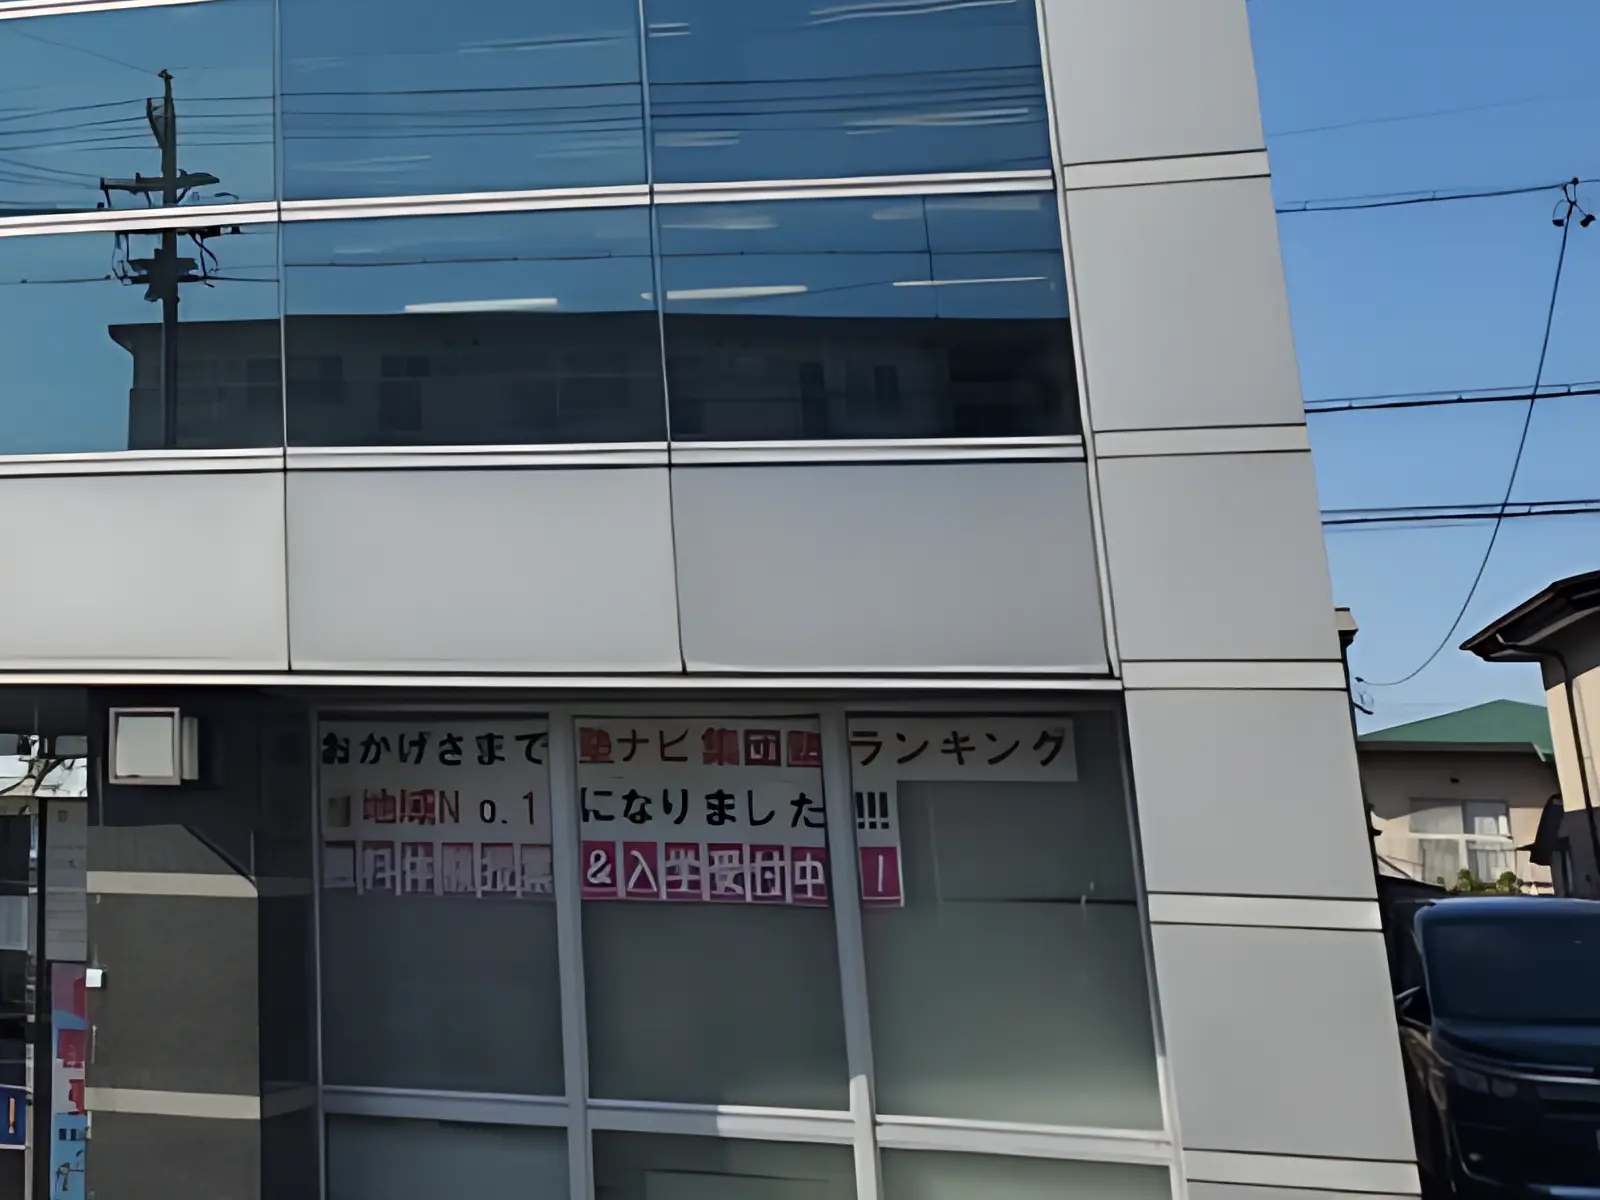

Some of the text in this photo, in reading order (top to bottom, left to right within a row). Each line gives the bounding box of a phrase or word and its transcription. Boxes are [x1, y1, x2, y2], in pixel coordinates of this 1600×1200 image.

[322, 731, 548, 765] おかげさまで
[850, 729, 1067, 767] ランキング
[581, 788, 825, 827] になりました
